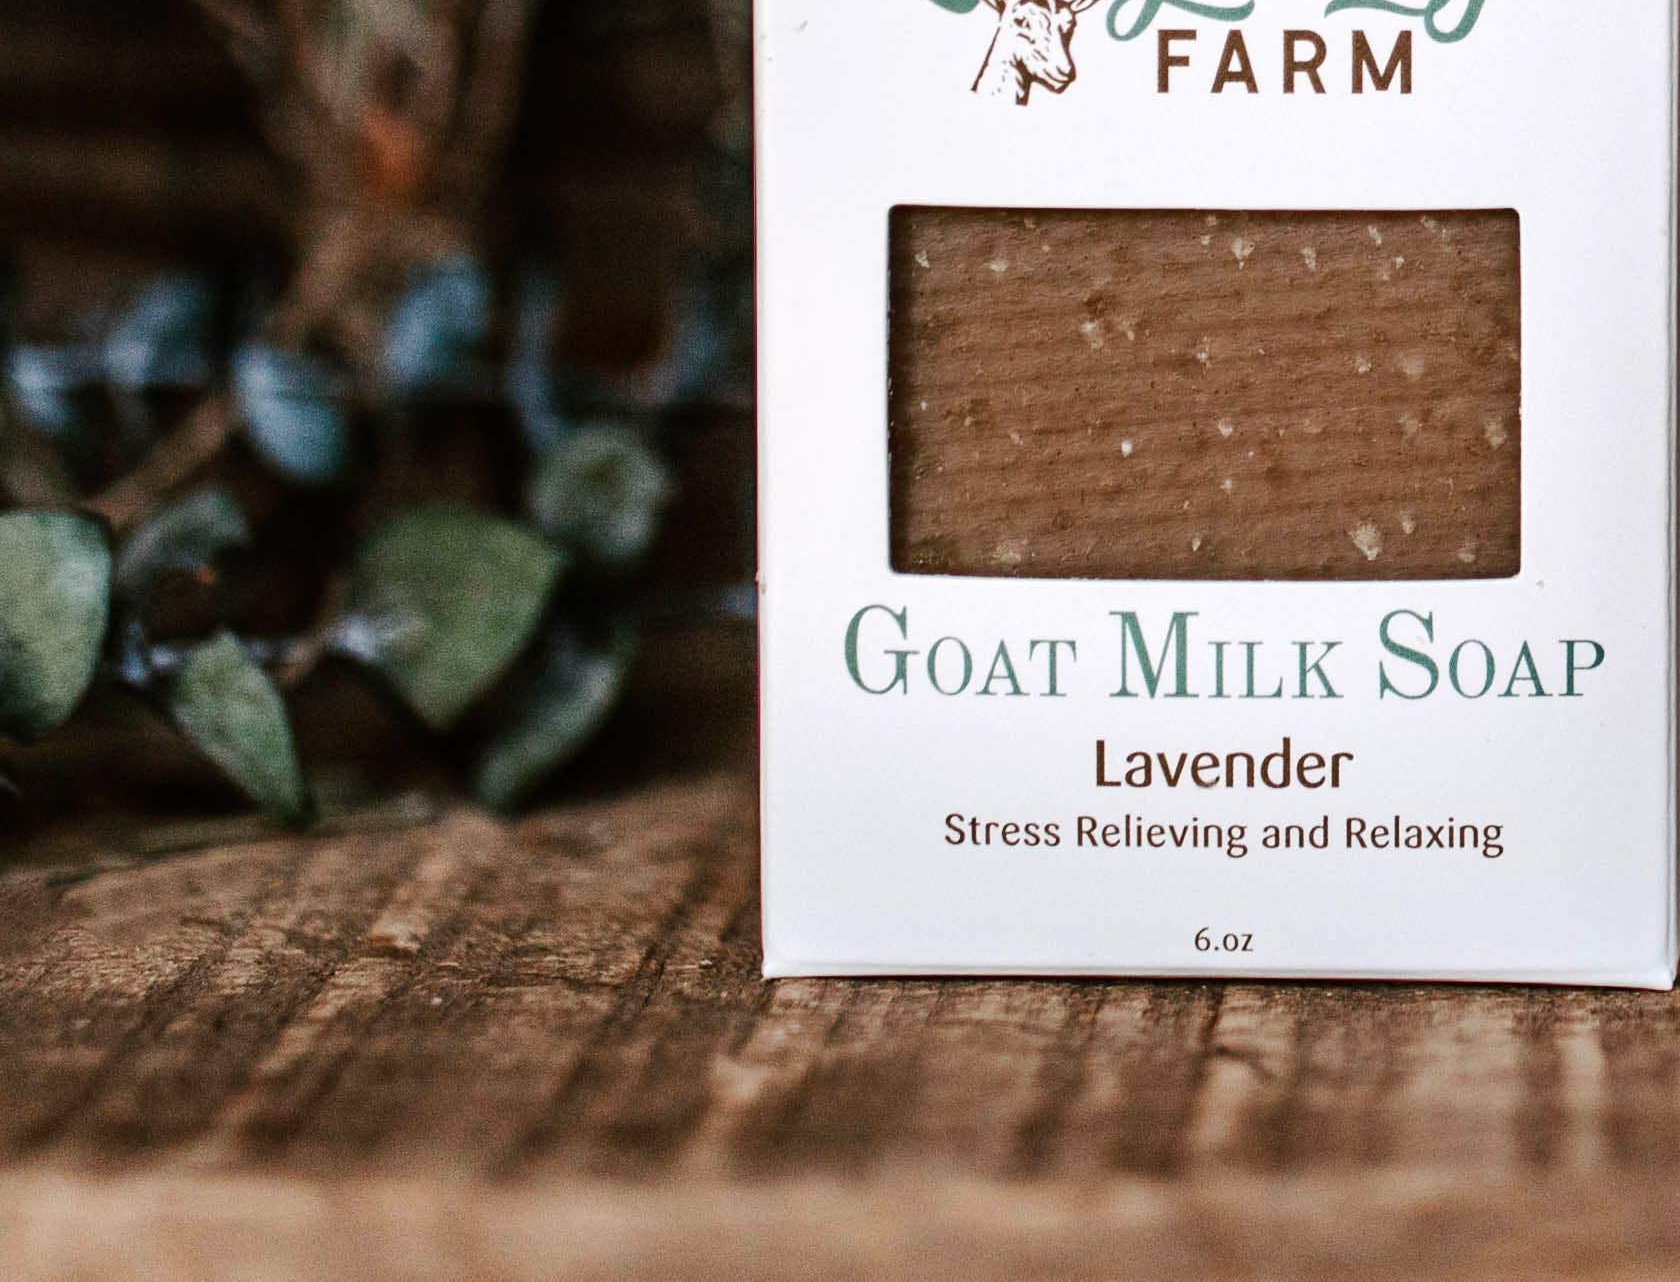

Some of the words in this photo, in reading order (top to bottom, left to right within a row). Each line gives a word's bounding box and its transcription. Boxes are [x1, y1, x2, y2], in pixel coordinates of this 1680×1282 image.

[1157, 28, 1412, 94] FARM
[1094, 736, 1354, 789] Lavender
[943, 812, 1061, 847] Stress
[1076, 814, 1249, 859] Relieving
[1261, 815, 1329, 849] and
[1345, 815, 1505, 859] Relaxing
[1193, 926, 1254, 953] 6.oz
